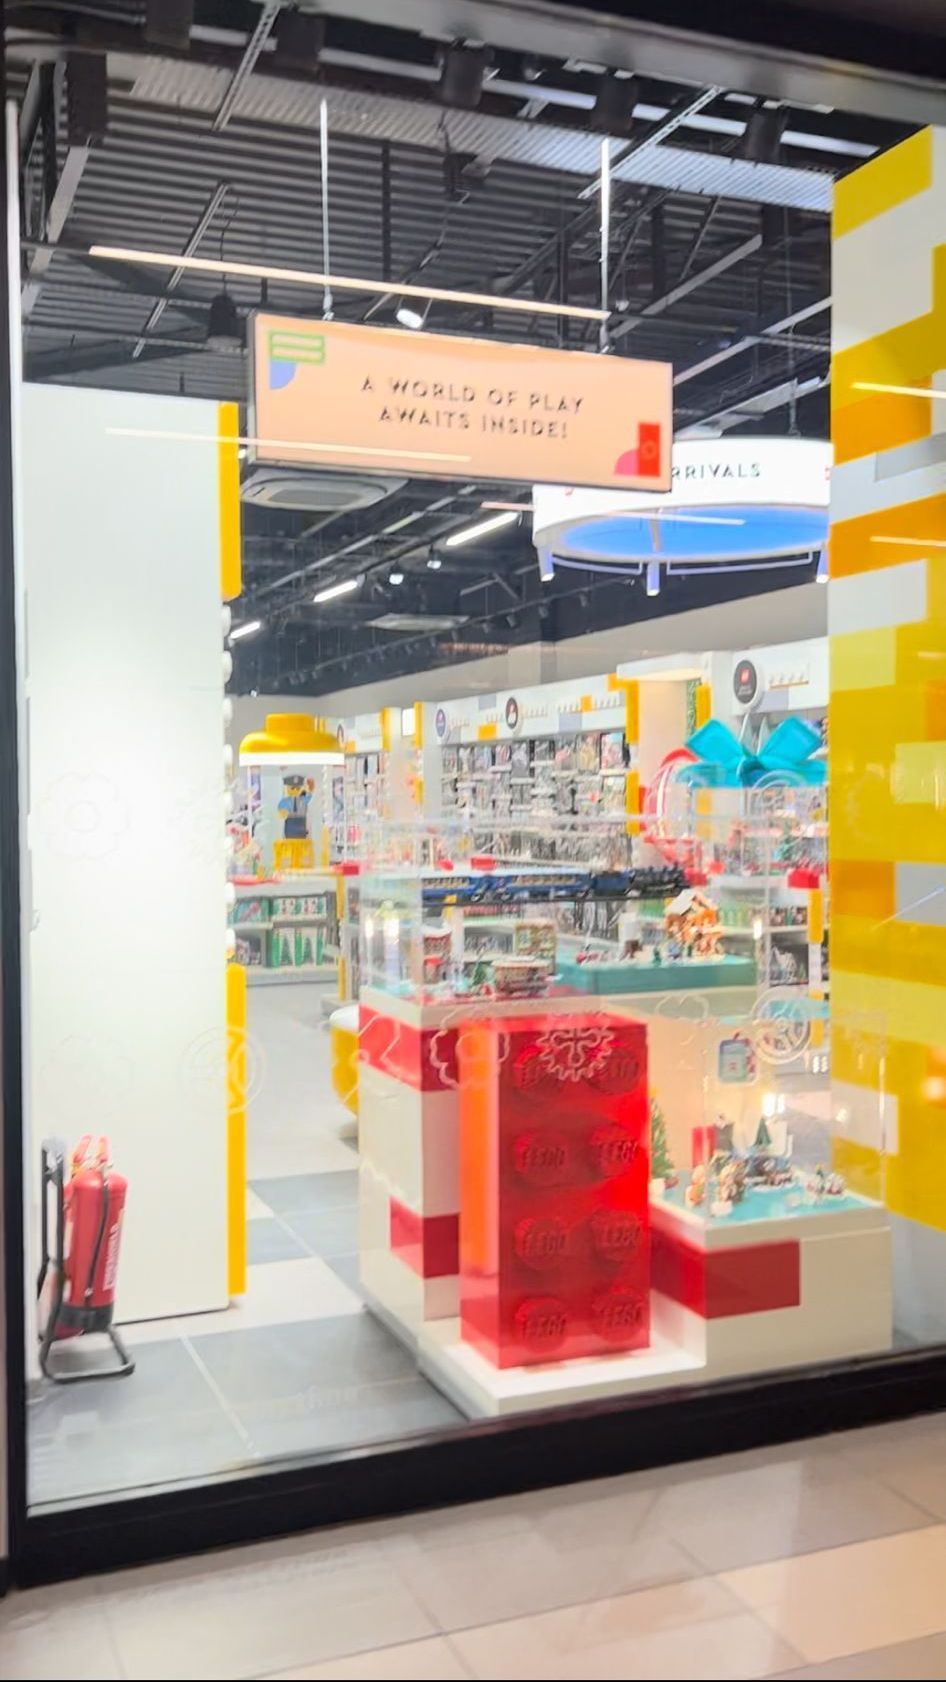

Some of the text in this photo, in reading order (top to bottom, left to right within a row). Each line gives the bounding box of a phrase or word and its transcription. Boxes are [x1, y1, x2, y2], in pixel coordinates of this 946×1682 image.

[361, 376, 583, 414] A WORLD OF PLAY
[379, 406, 567, 439] AWAITS INSIDE!
